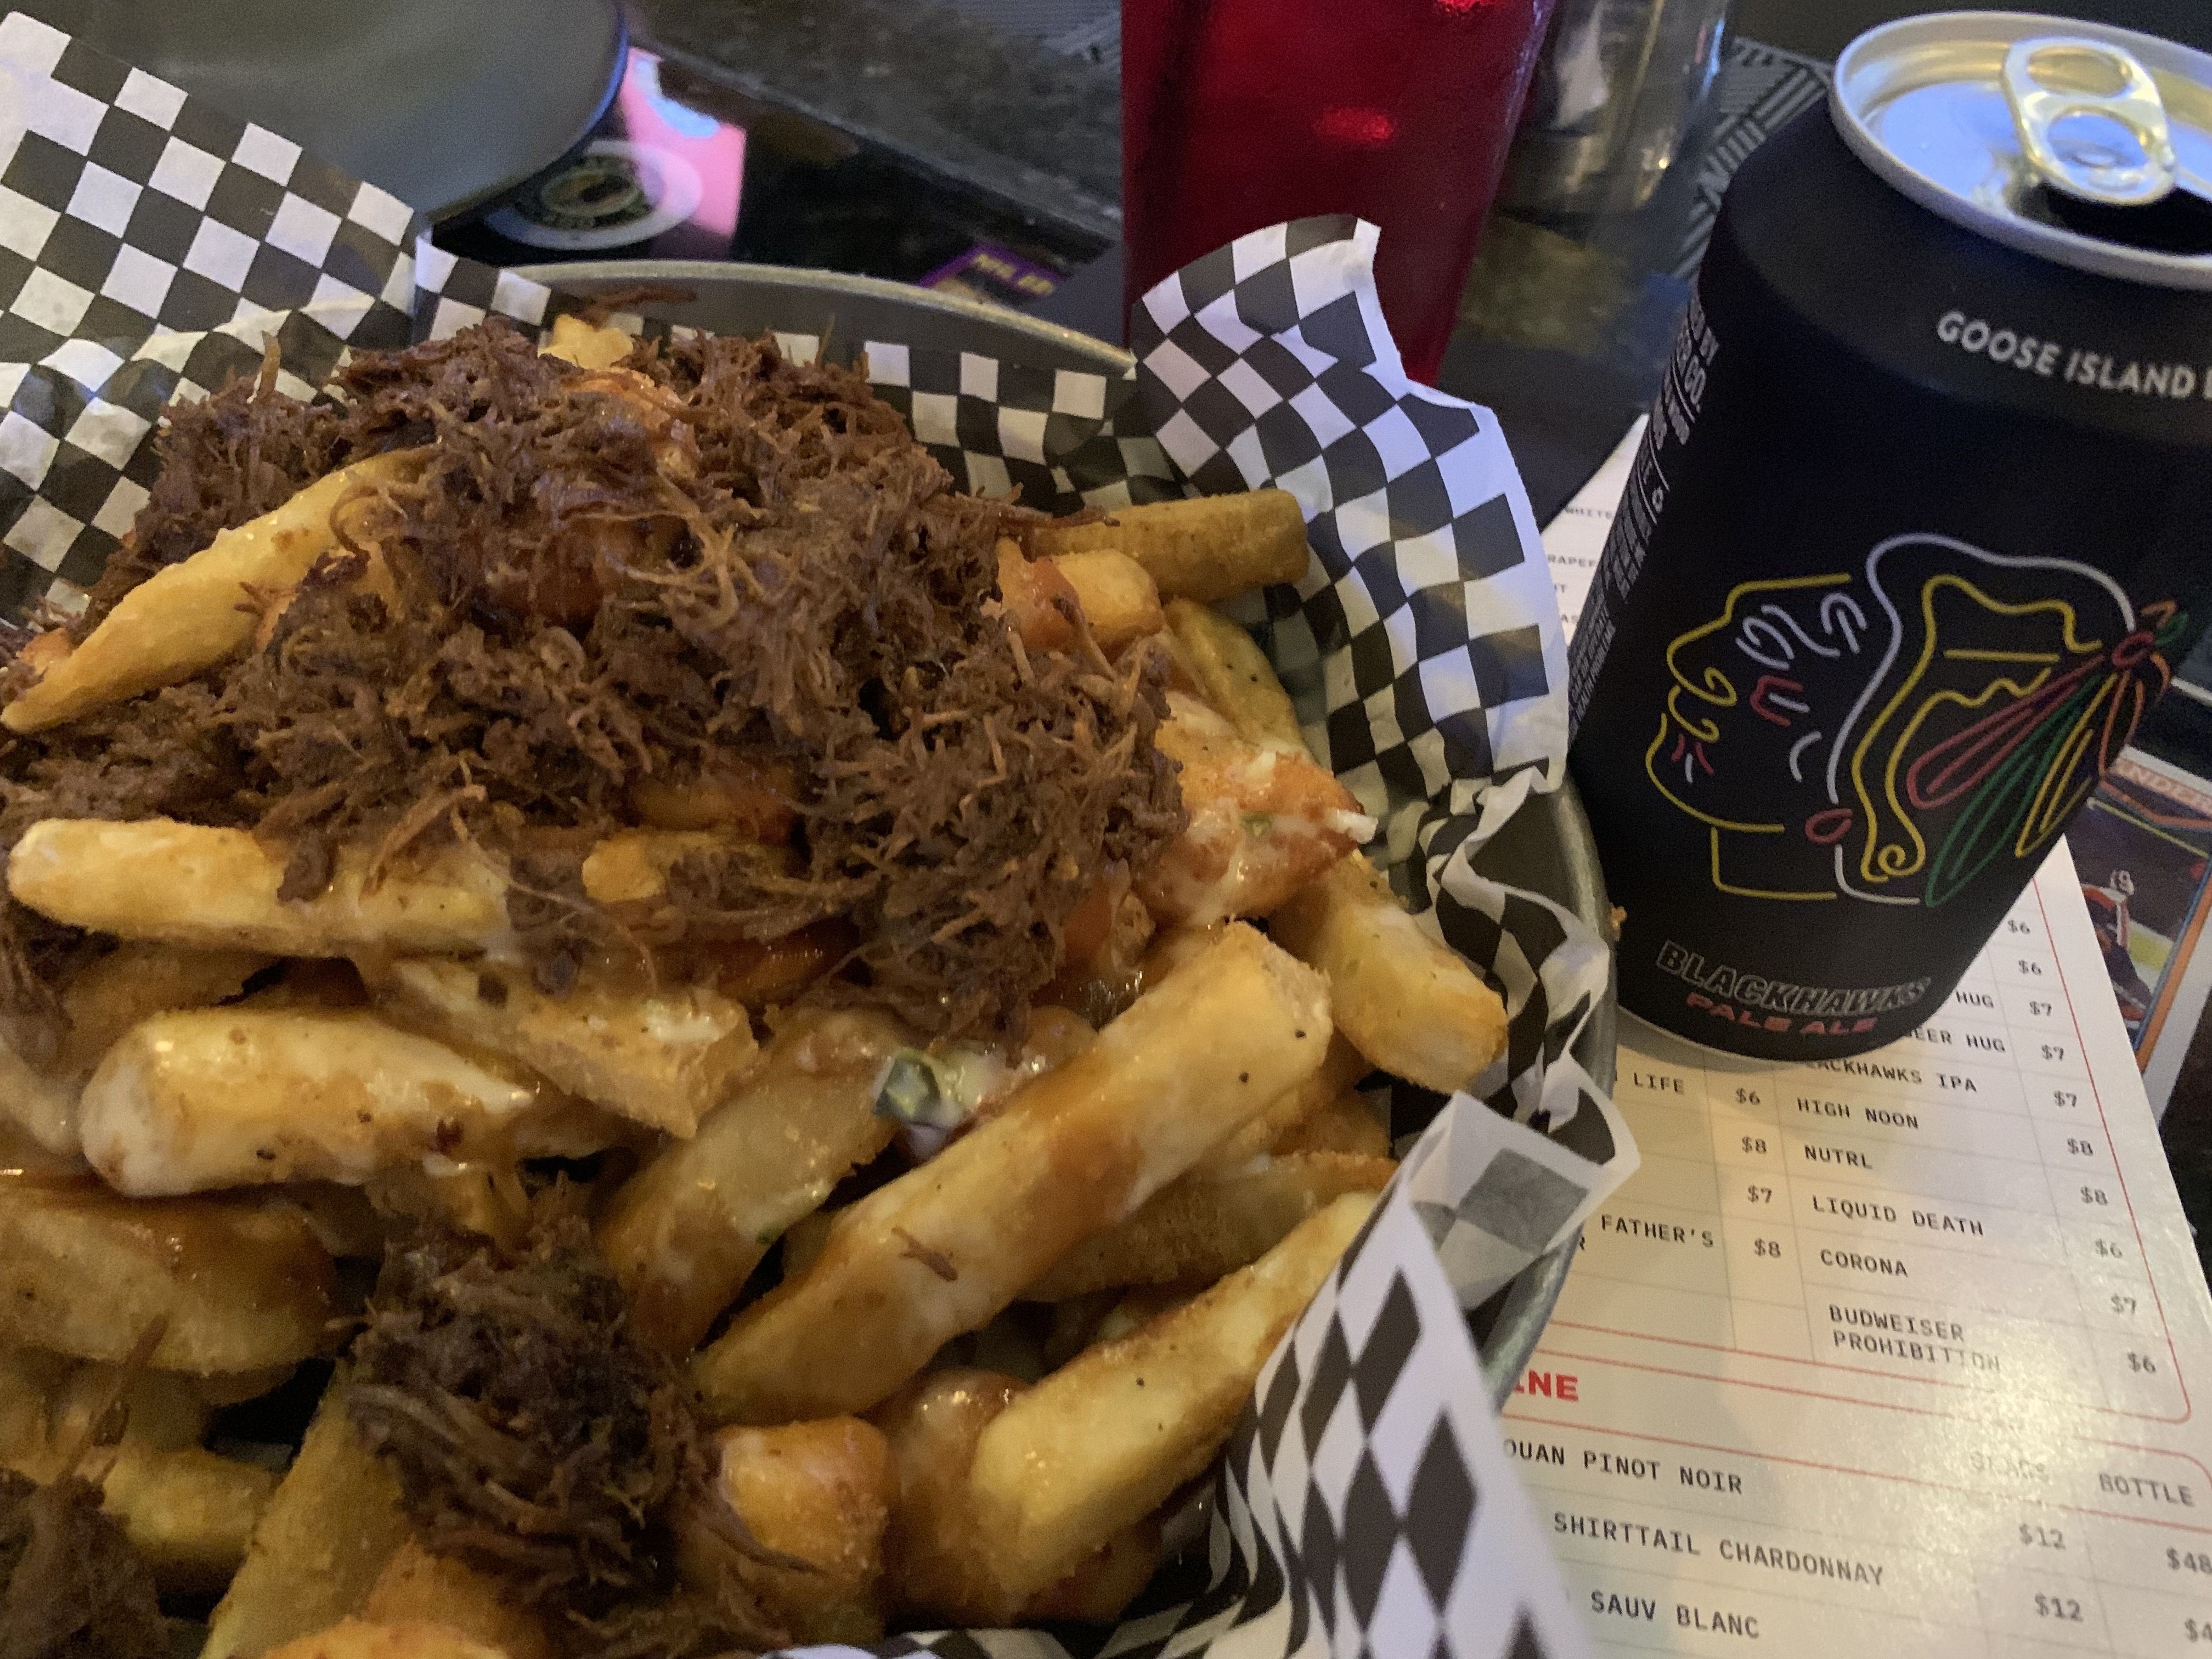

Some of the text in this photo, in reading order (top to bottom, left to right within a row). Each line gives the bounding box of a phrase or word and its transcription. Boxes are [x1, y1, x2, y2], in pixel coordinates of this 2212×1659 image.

[1937, 311, 2061, 377] GOOSE
[2064, 349, 2196, 398] ISLAND
[2007, 919, 2030, 934] $6
[1656, 940, 1931, 1017] BLACKHAWKS
[2018, 960, 2042, 975] $6
[1686, 992, 1878, 1035] PALE ALE
[1956, 991, 2052, 1016] HUG $7
[1909, 1029, 2064, 1060] EER HUG $7
[1634, 1073, 1684, 1094] LIFE
[1736, 1087, 1760, 1105] $6
[1937, 1073, 1977, 1092] IPA
[2053, 1091, 2077, 1107] $7
[1742, 1136, 1767, 1154] $8
[1797, 1098, 2093, 1156] HIGH NOON $8
[1747, 1184, 1772, 1204] $7
[1804, 1145, 2108, 1206] NUTRL $8
[1601, 1214, 1714, 1248] FATHER'S
[1754, 1238, 1781, 1258] $8
[1812, 1195, 2123, 1259] LIQUID DEATH $6
[1820, 1249, 2137, 1314] CORONA $7
[1829, 1304, 1964, 1342] BUDWEISER
[1832, 1330, 2157, 1374] PROHIBITION $6
[1515, 1369, 1578, 1402] NE
[2098, 1472, 2193, 1507] BOTTLE
[1583, 1450, 1661, 1480] PINOT
[1680, 1466, 1742, 1494] NOIR
[2019, 1523, 2066, 1550] $12
[2166, 1546, 2212, 1575] $48
[1554, 1512, 2212, 1643] SHIRTTAIL CHARDONNAY $12 $4
[1591, 1590, 1760, 1639] SAUV BLANC
